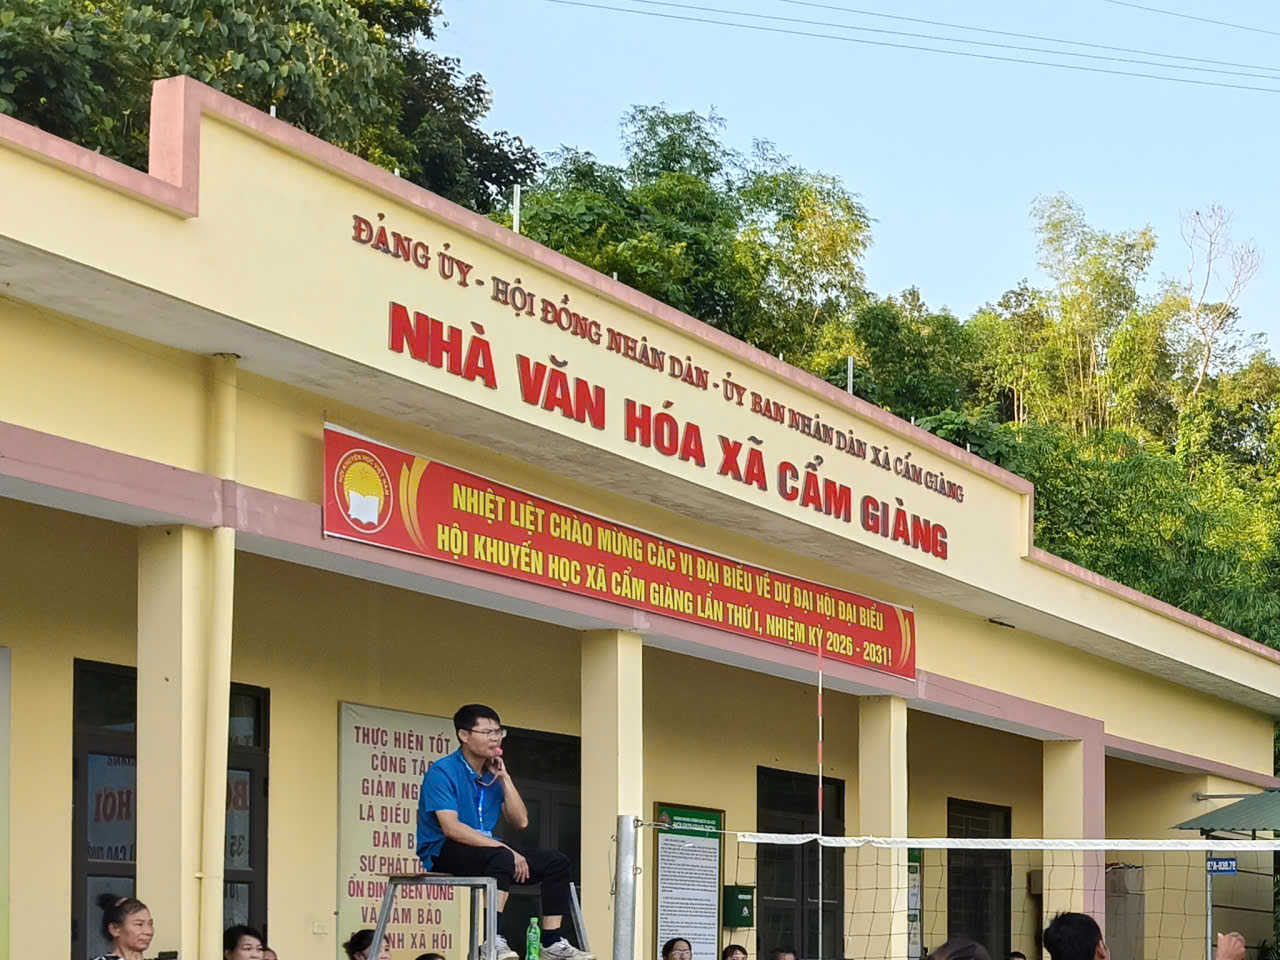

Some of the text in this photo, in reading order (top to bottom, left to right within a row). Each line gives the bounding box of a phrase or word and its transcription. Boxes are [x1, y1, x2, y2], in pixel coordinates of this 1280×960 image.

[352, 212, 430, 269] ĐẢNG
[437, 242, 473, 288] ỦY
[491, 276, 535, 317] HỘI
[606, 328, 665, 372] NHÂN
[668, 355, 709, 390] DÂN
[722, 372, 747, 406] ỦY
[750, 391, 786, 424] BAN
[788, 408, 834, 445] NHÂN
[835, 429, 867, 460] DÂN
[870, 446, 891, 471] XÃ
[893, 452, 923, 485] CẨM
[924, 471, 964, 502] GIÀNG
[388, 301, 948, 560] NHÀ VĂN HÓA XÃ CẨM GIÀNG
[452, 482, 884, 632] NHIỆT LIỆT CHÀO MỪNG CÁC VỊ ĐẠI BIỂU VỀ DỰ ĐẠI HỘI ĐẠI BIỂU
[436, 522, 468, 560] HỘI
[474, 533, 544, 576] KHUYẾN
[548, 554, 581, 587] HỌC
[585, 563, 607, 594] XÃ
[611, 566, 645, 601] CẨM
[650, 580, 694, 615] GIÀNG
[697, 590, 724, 623] LẦN
[727, 603, 752, 628] THỨ
[766, 613, 806, 646] NHIỆM
[826, 631, 853, 656] 2026
[863, 640, 892, 666] 2031!
[354, 725, 451, 754] THỰC HIỆN TỐT
[371, 751, 406, 774] CÔNG
[361, 774, 396, 798] GIẢM
[359, 801, 375, 821] LÀ
[373, 825, 402, 849] ĐẢM
[359, 854, 377, 876] SỰ
[379, 854, 409, 873] PHÁT
[361, 902, 377, 923] VÀ
[417, 903, 442, 925] BẢO
[410, 930, 426, 950] XÃ
[431, 929, 452, 953] HỘI
